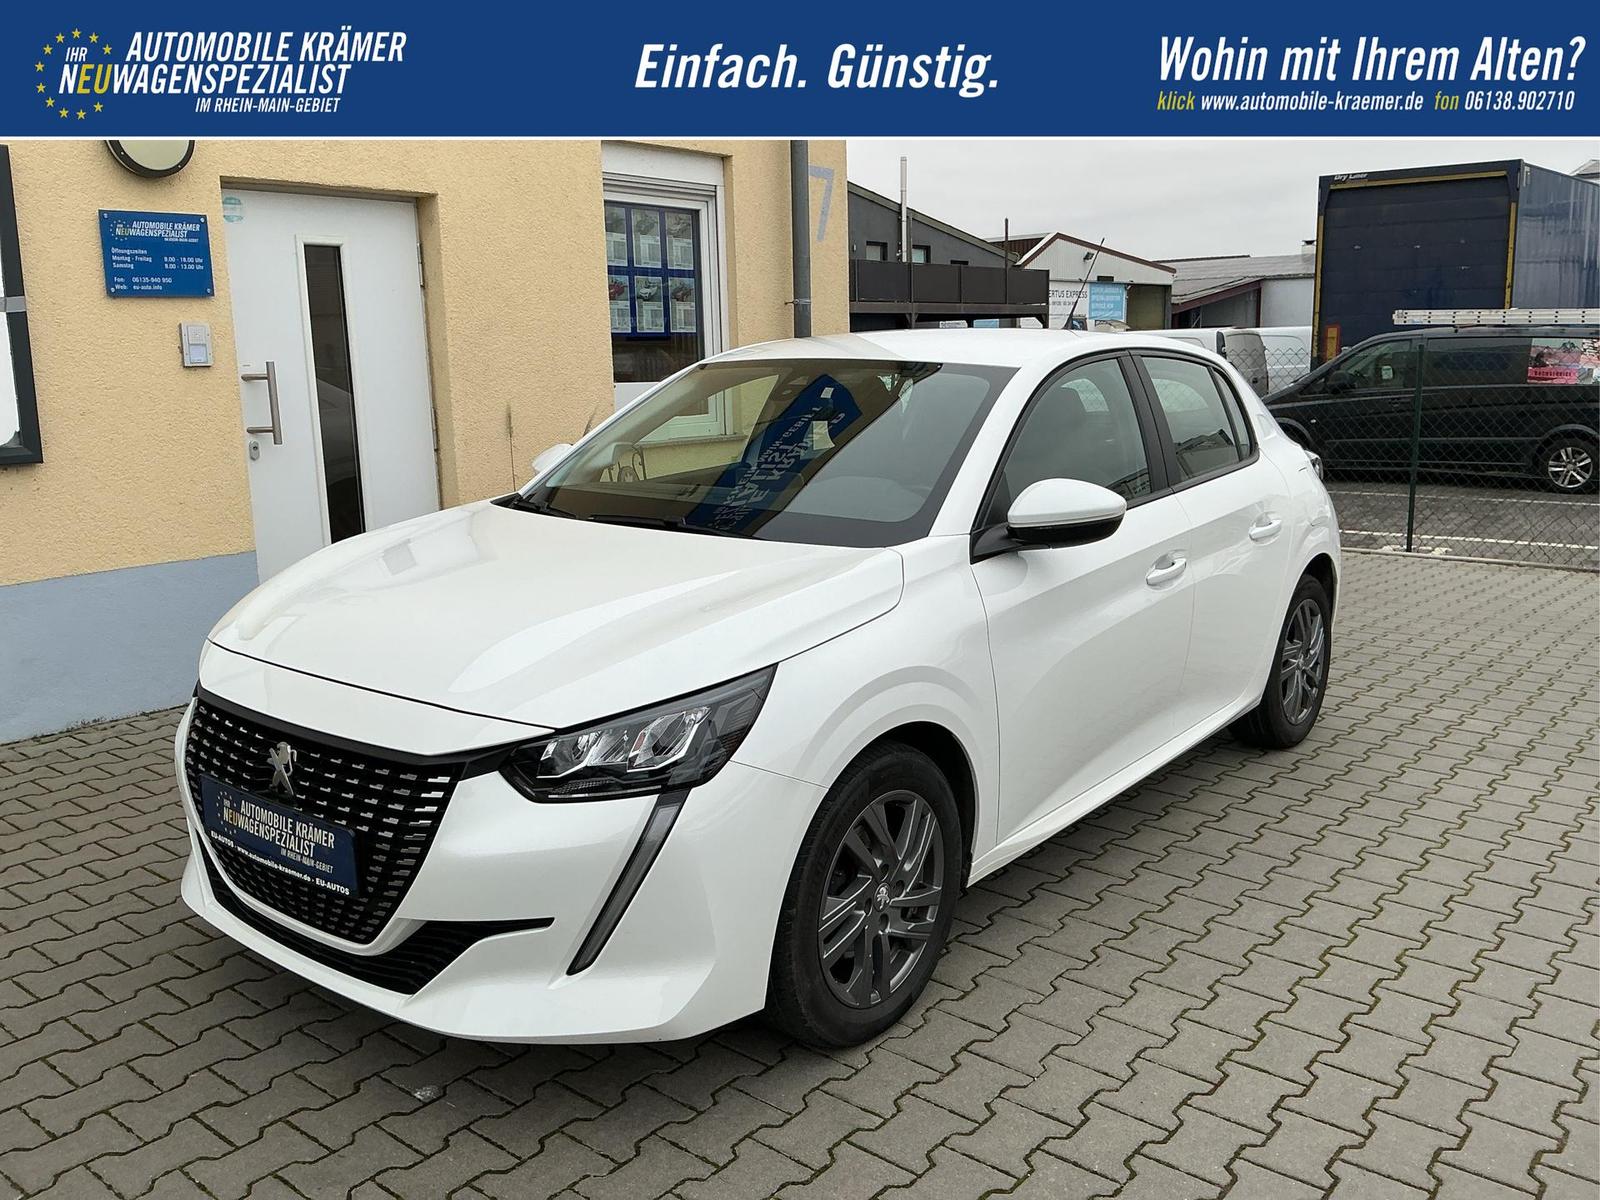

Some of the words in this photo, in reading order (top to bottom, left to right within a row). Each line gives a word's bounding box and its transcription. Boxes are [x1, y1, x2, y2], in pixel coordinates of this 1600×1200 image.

[132, 221, 173, 230] AUTOMOBILE
[174, 222, 200, 231] KRÄMER
[115, 227, 188, 238] NEUWAGENSPEZIALIST
[135, 255, 152, 263] Freitag
[112, 262, 134, 270] Samstag
[240, 800, 293, 833] AUTOMOBILE
[296, 821, 335, 849] KRÄMER
[223, 807, 315, 857] NEUWAGENSPEZIALIST
[316, 878, 350, 895] EU-AUTOS
